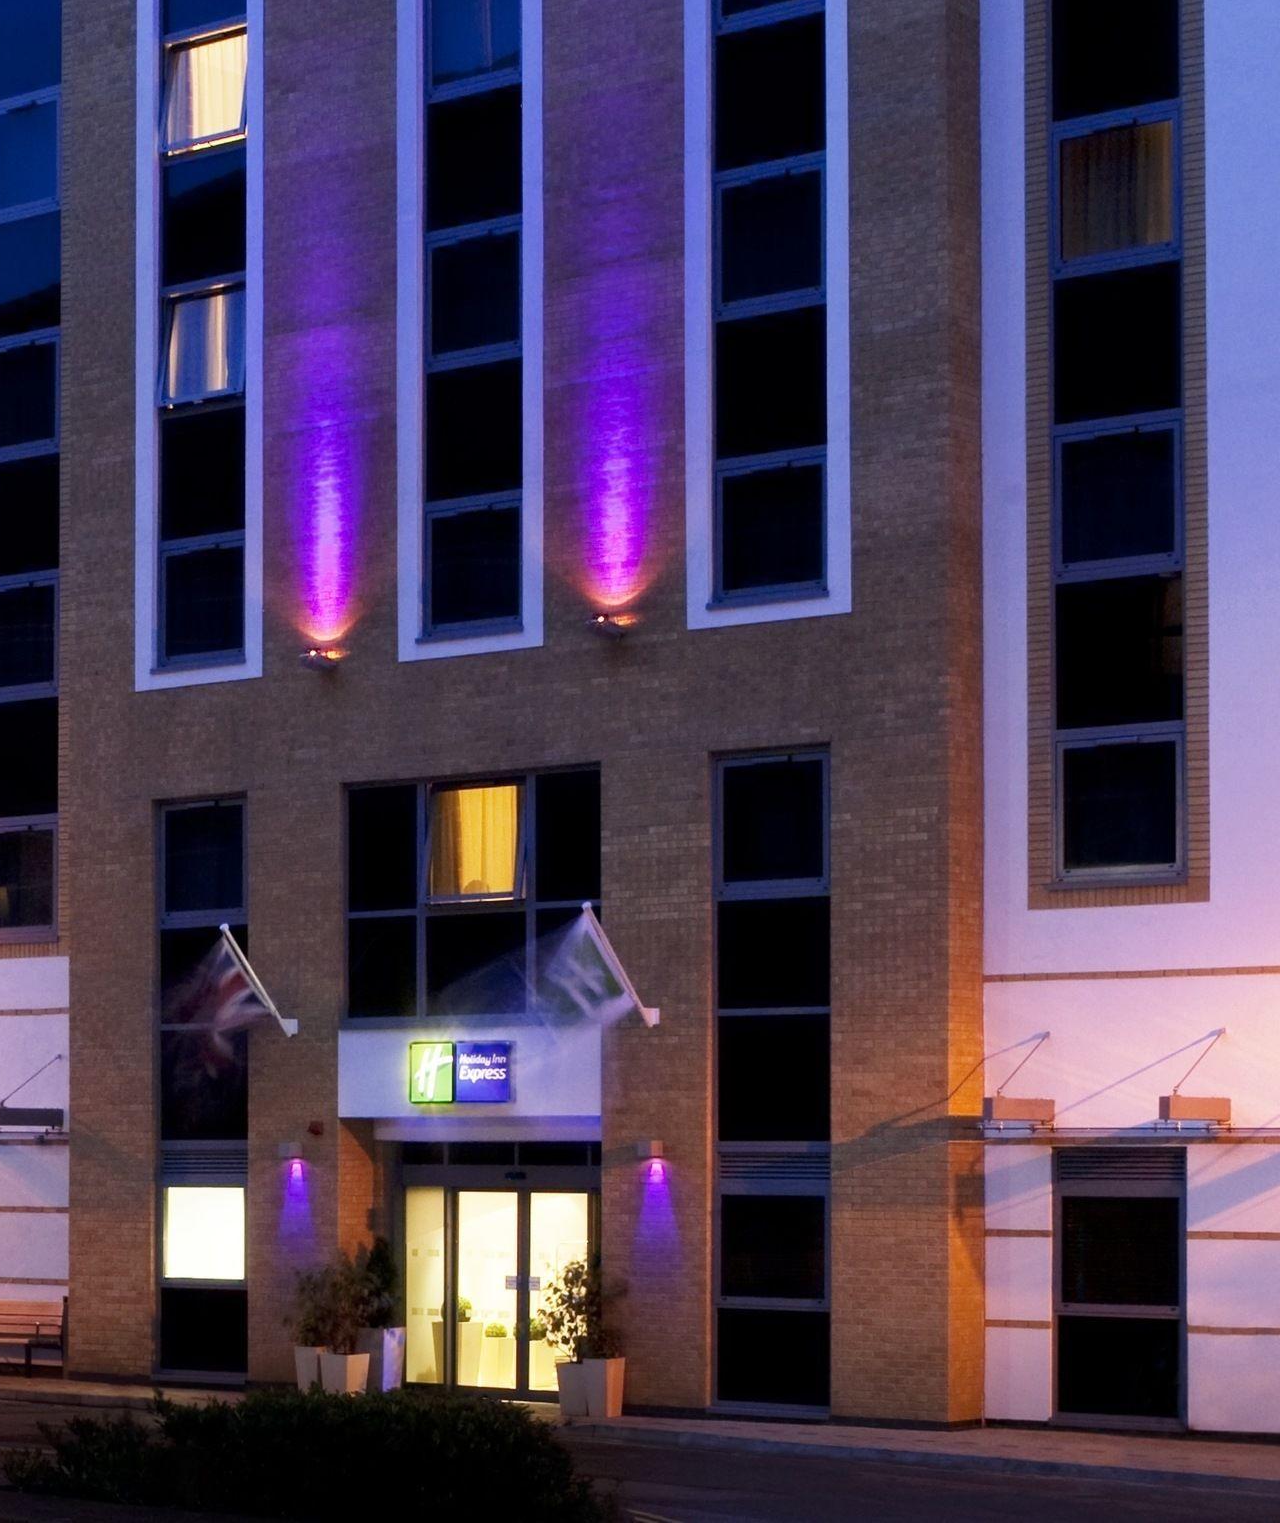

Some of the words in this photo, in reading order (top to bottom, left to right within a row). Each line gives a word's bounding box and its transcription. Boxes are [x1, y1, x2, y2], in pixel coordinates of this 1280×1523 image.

[459, 1053, 491, 1066] Holiday
[491, 1053, 507, 1064] Inn
[458, 1065, 507, 1083] Express
